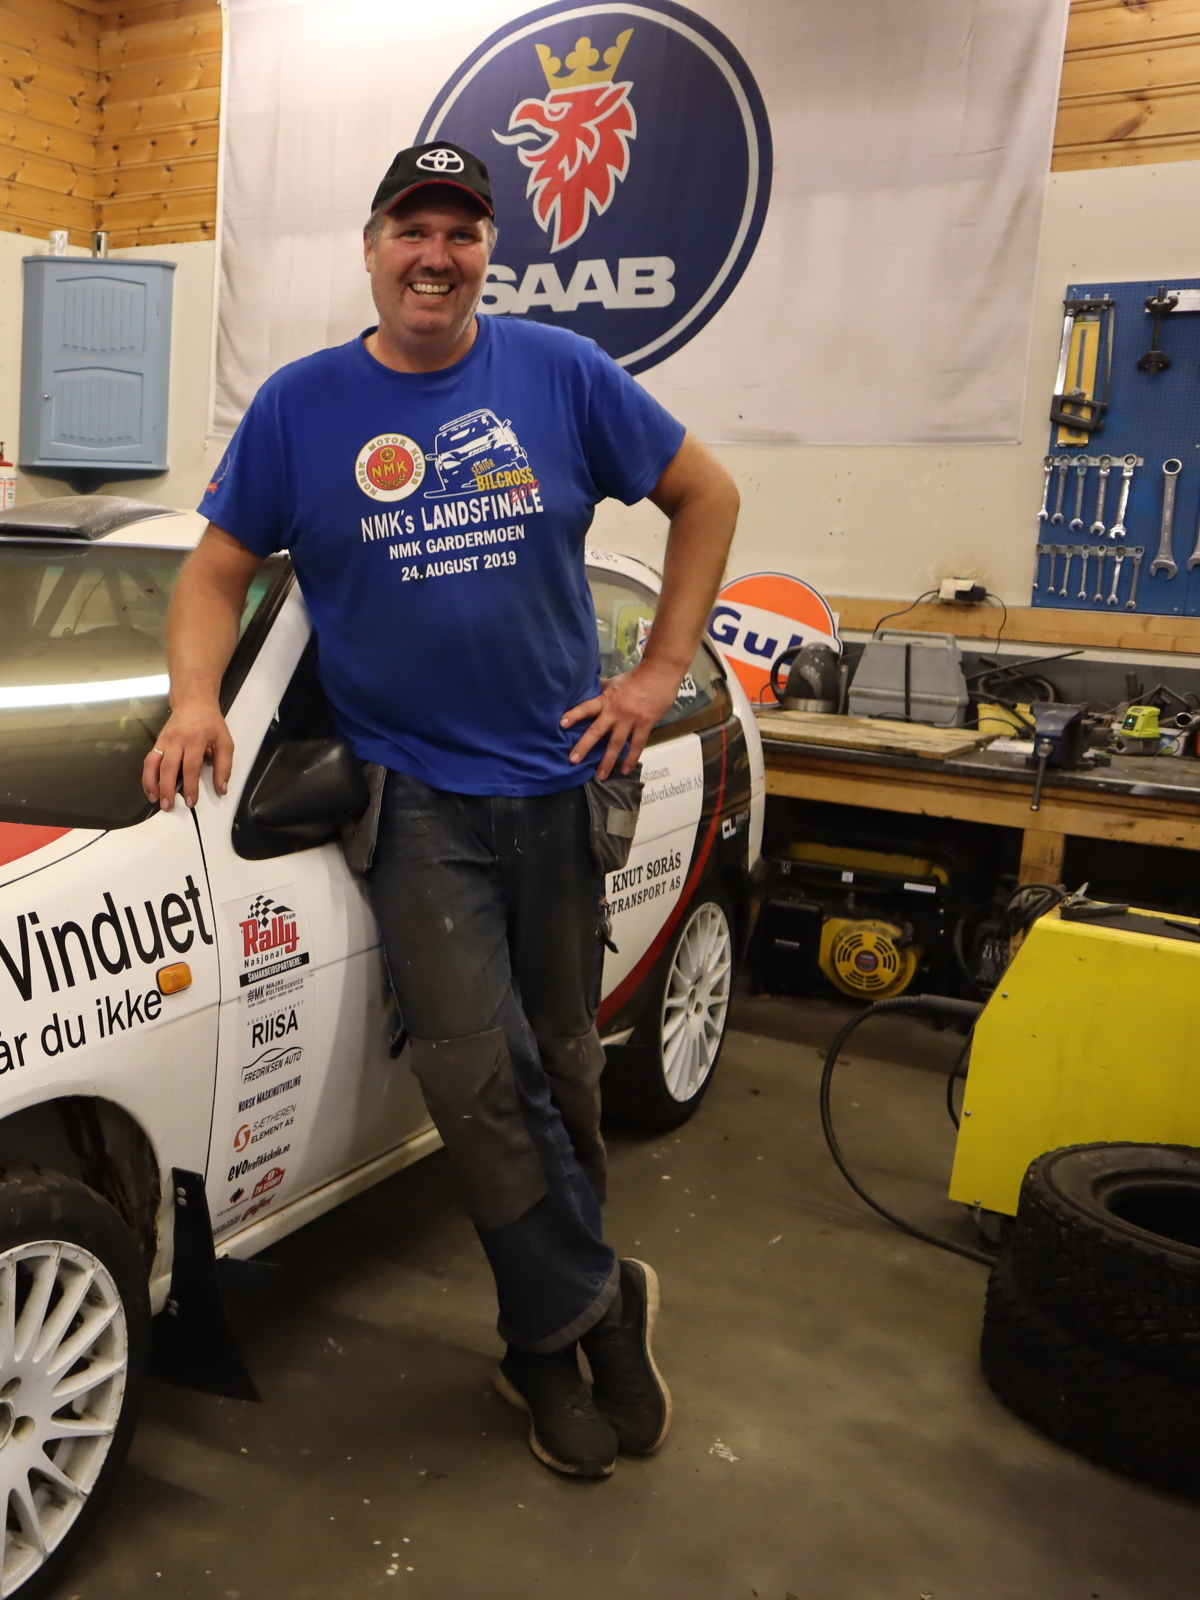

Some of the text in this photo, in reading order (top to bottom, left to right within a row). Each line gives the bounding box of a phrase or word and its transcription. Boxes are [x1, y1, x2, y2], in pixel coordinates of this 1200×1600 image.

[476, 255, 676, 315] SAAB
[368, 436, 408, 453] MOTOR
[358, 461, 378, 497] NORSK
[371, 459, 409, 479] NMK
[409, 447, 424, 486] KLUBB
[470, 457, 496, 477] SENIOR
[475, 467, 535, 492] BILCROSS
[360, 487, 545, 543] NMK's LANDSFINALE
[388, 524, 526, 560] NMK GARDERMOEN
[401, 551, 517, 582] 24. AUGUST 2019
[706, 605, 804, 667] Gul
[641, 766, 671, 784] stiansen
[693, 773, 704, 790] AS
[611, 847, 682, 894] KNUT SØRÅS
[611, 875, 681, 916] TRANSPORT AS
[282, 912, 296, 922] Team
[238, 915, 300, 958] Rally
[244, 947, 283, 969] Nasjonal
[265, 978, 304, 997] KULTURSERVICE
[266, 979, 284, 990] MAJAS
[40, 1012, 87, 1055] du
[96, 986, 162, 1039] ikke
[246, 999, 304, 1026] ADVOKATFIRMAET
[251, 1009, 299, 1049] RIISA
[243, 1052, 302, 1085] FREDRIKSEN AUTO
[238, 1096, 256, 1113] NORSK
[252, 1103, 297, 1132] SÆTHEREN
[251, 1116, 295, 1144] ELEMENT AS
